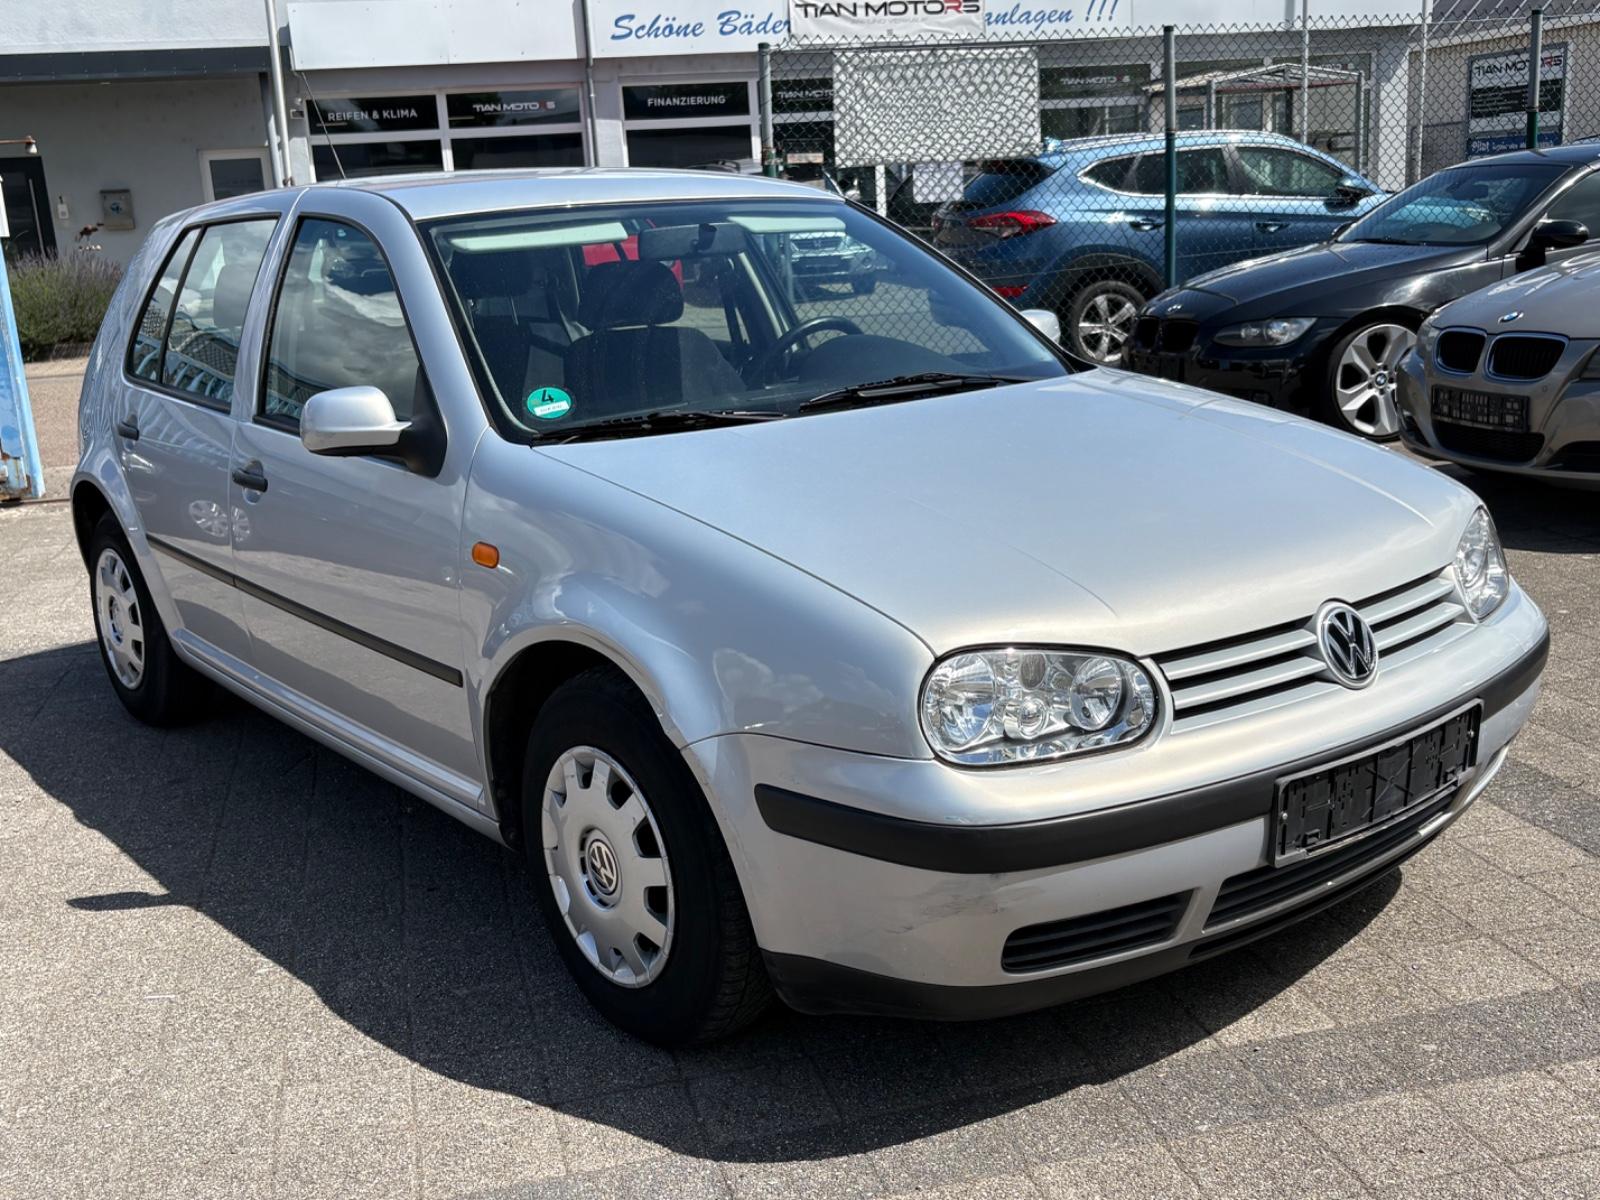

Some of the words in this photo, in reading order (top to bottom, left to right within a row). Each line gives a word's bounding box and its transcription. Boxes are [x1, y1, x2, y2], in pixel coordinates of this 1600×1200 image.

[795, 2, 858, 19] TIAN
[864, 0, 981, 18] MOTORS
[610, 14, 705, 41] Schöne
[472, 103, 501, 112] TIAN
[647, 95, 726, 107] FINANZIERUNG
[327, 110, 370, 122] REIFEN
[372, 109, 380, 120] &
[382, 108, 418, 119] KLIMA
[541, 389, 555, 402] 4
